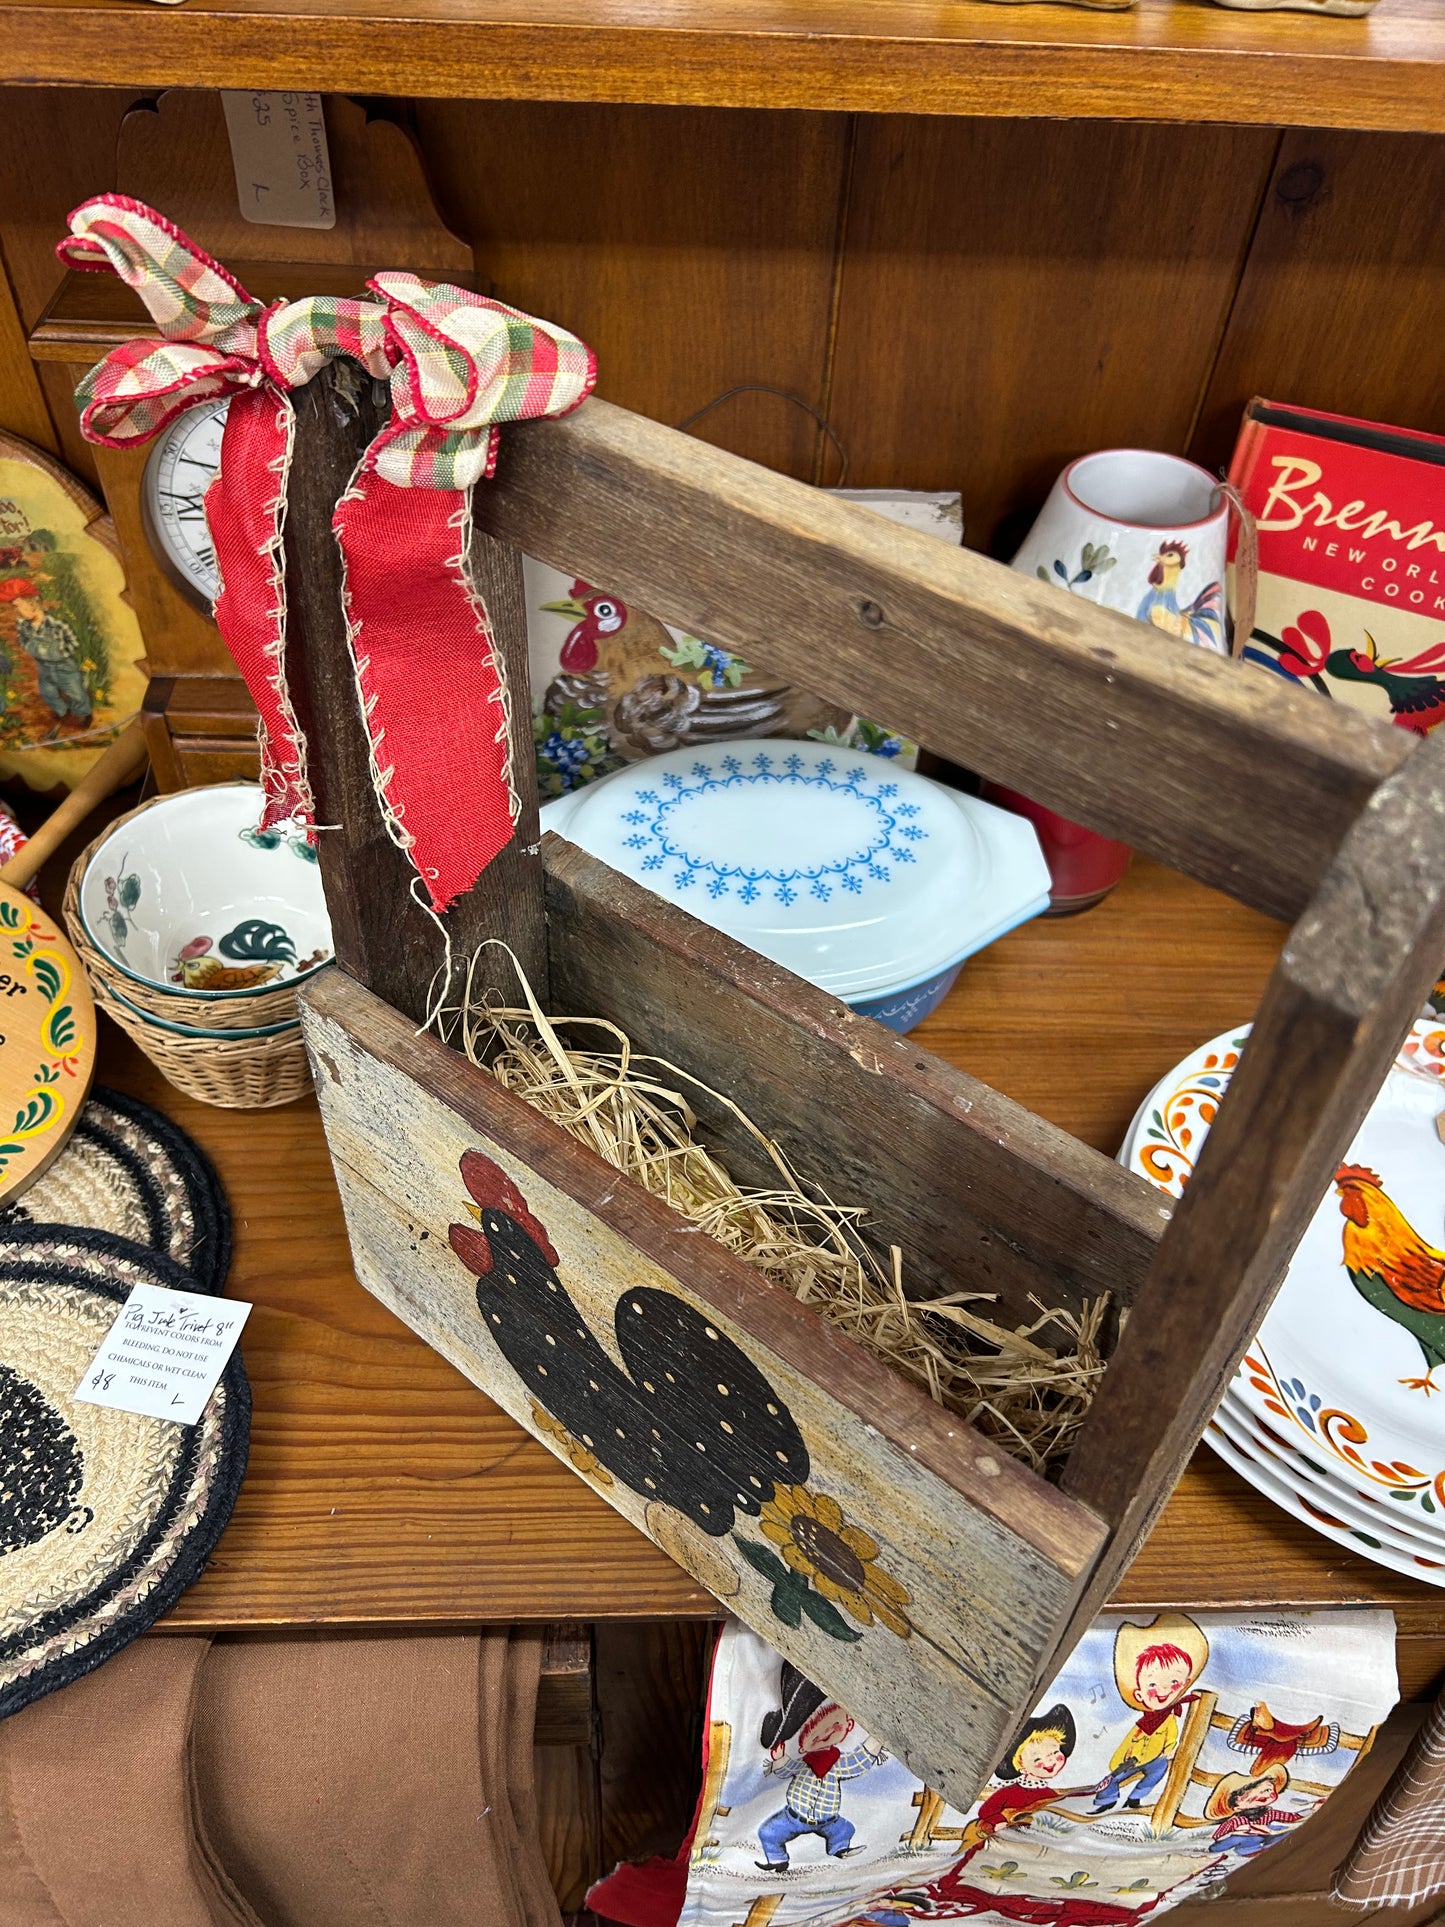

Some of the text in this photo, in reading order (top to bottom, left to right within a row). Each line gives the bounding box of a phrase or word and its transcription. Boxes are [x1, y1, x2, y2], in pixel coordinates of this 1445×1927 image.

[281, 91, 315, 190] Spice Box
[308, 119, 325, 174] Thomas
[316, 175, 331, 217] Clock
[1303, 536, 1366, 564] NEW
[1361, 576, 1445, 611] COOK
[124, 1303, 145, 1330] Pig
[178, 1312, 214, 1334] Trivet
[216, 1321, 235, 1337] 8"
[169, 1331, 199, 1345] COLORS
[200, 1338, 223, 1348] FROM
[107, 1352, 207, 1380] CHEMICALS OR WET CLEAN
[162, 1346, 175, 1356] DO
[176, 1350, 194, 1360] NOT
[194, 1353, 208, 1363] USE
[129, 1375, 147, 1386] THIS
[170, 1392, 185, 1406] L
